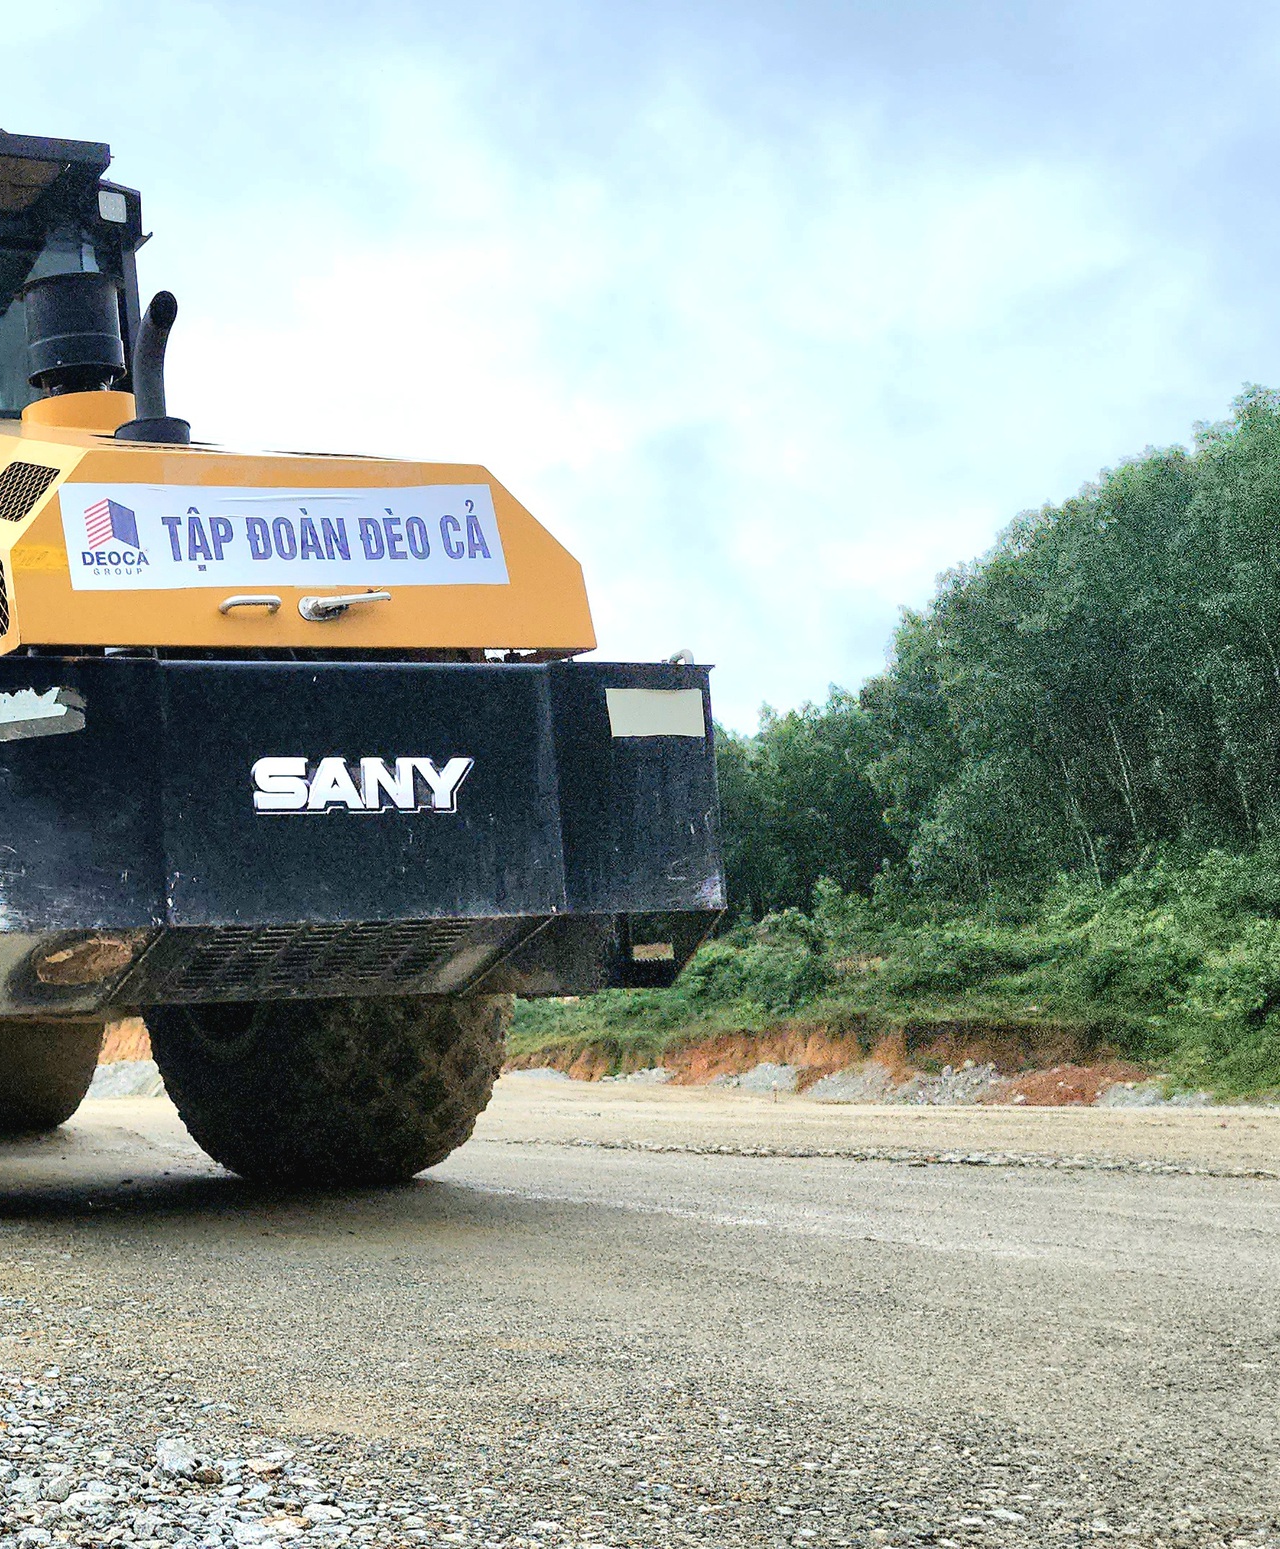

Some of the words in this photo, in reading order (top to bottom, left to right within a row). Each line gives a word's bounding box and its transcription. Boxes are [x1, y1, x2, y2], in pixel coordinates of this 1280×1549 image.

[161, 507, 234, 572] TẬP
[245, 508, 352, 561] ĐOÀN
[358, 508, 432, 561] ĐÈO
[440, 499, 492, 560] CẢ
[81, 551, 150, 566] DEOCA
[93, 567, 143, 576] GROUP
[251, 756, 475, 814] SANY
